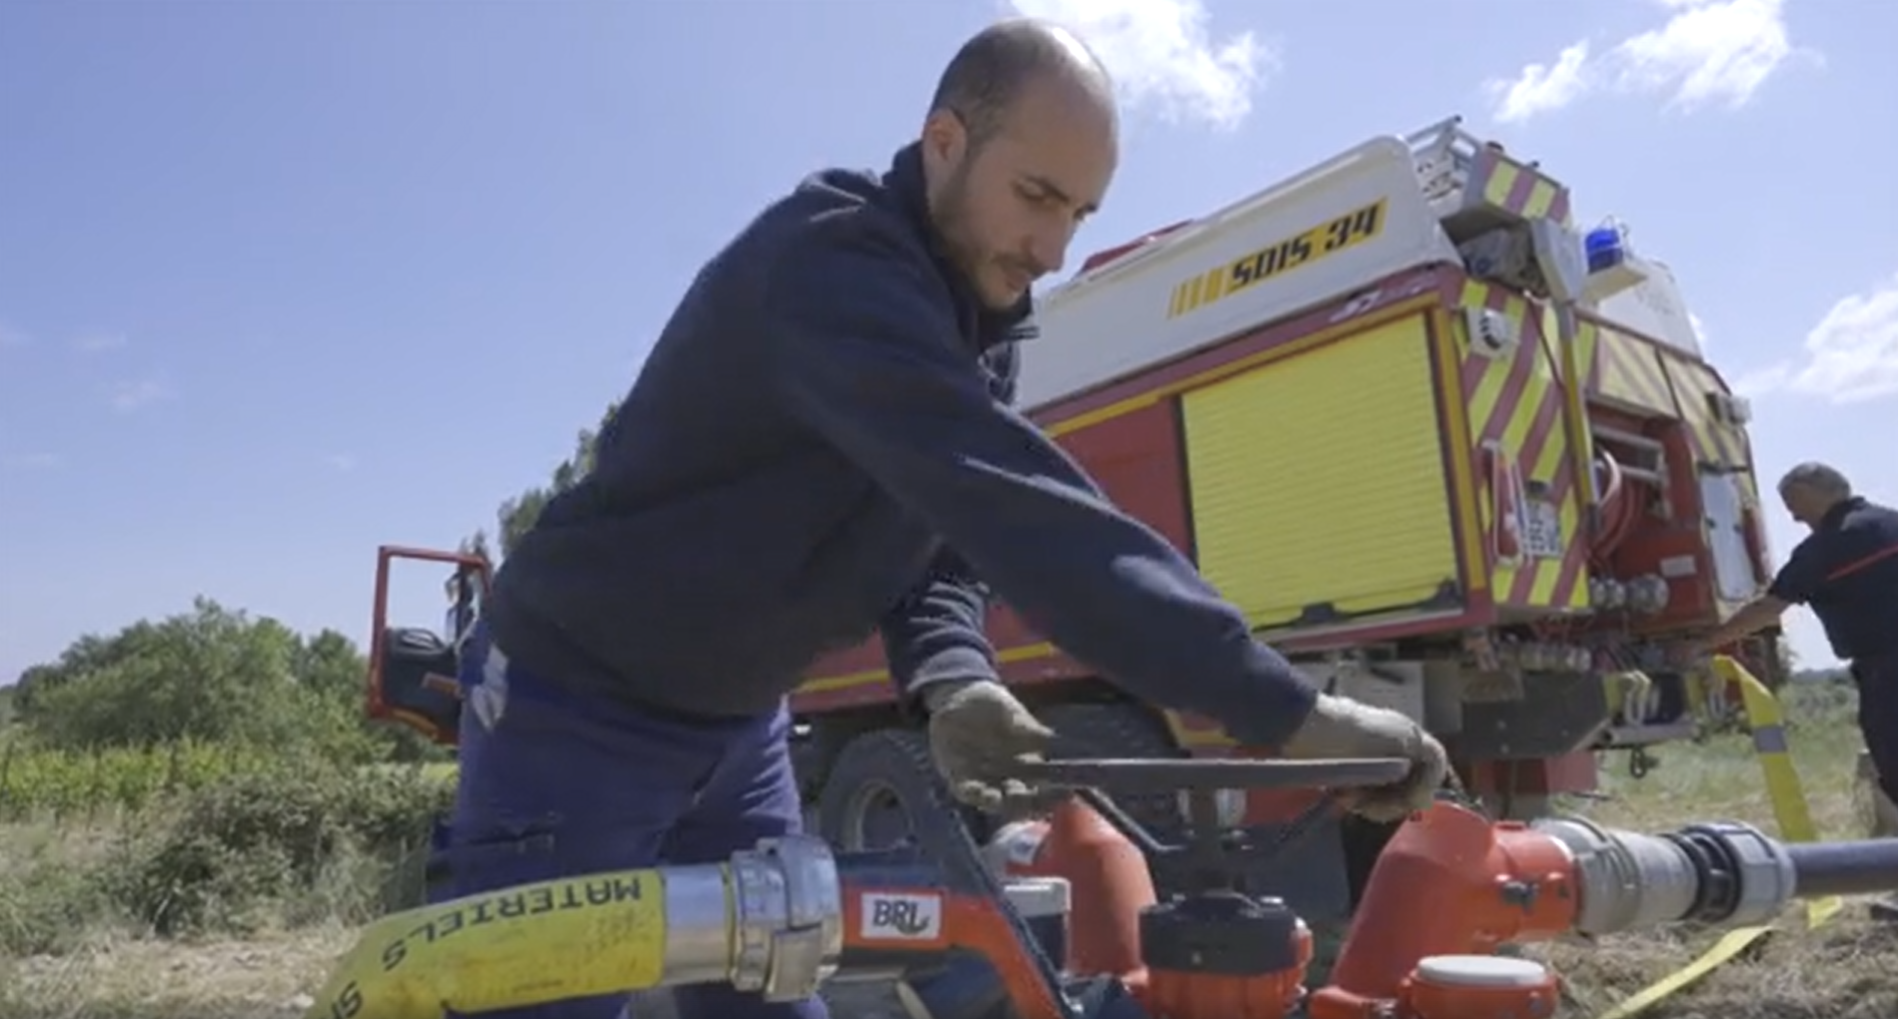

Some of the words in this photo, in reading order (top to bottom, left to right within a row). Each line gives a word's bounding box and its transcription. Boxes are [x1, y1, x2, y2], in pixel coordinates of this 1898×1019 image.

[1232, 233, 1312, 288] SDIS
[1325, 204, 1378, 251] 34
[382, 875, 641, 972] MATERIELS
[873, 899, 930, 934] BRL
